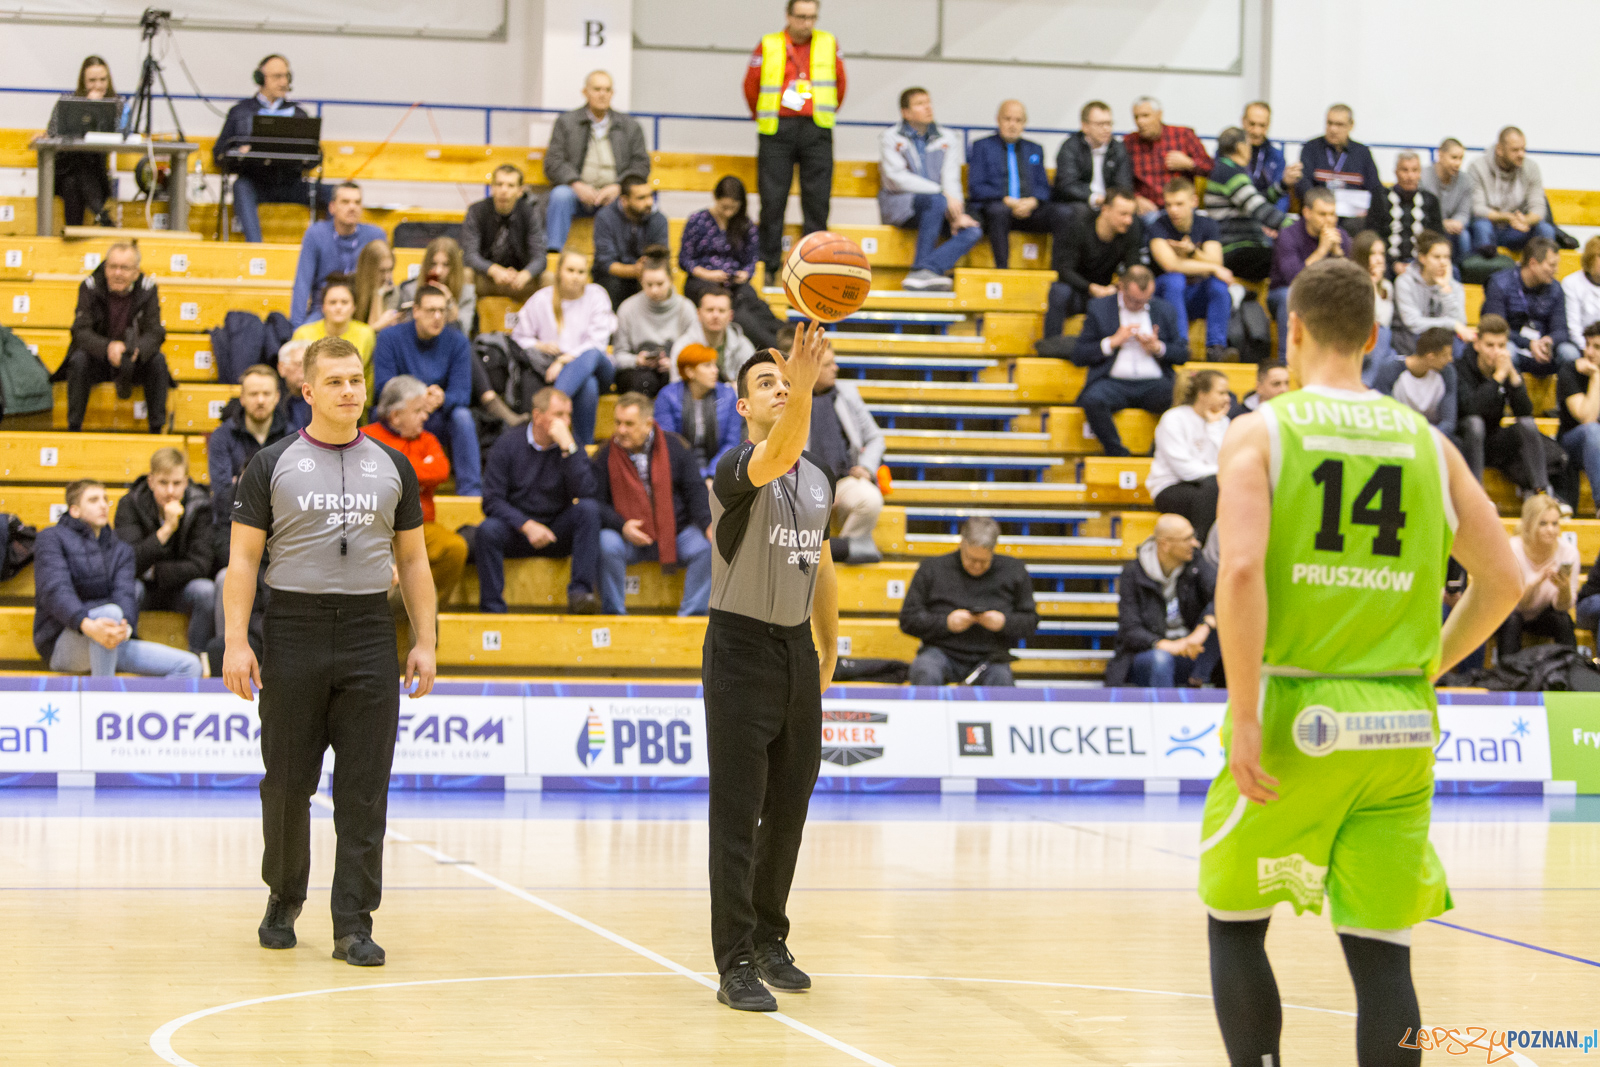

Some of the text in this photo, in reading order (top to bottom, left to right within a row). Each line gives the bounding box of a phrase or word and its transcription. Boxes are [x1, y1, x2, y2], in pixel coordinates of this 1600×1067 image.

[583, 20, 606, 47] B
[326, 511, 375, 526] active
[1312, 458, 1407, 557] 14
[1291, 563, 1415, 592] PRUSZKÓW
[609, 704, 692, 718] fundacja
[612, 719, 692, 764] PBG
[1009, 726, 1146, 755] NICKEL
